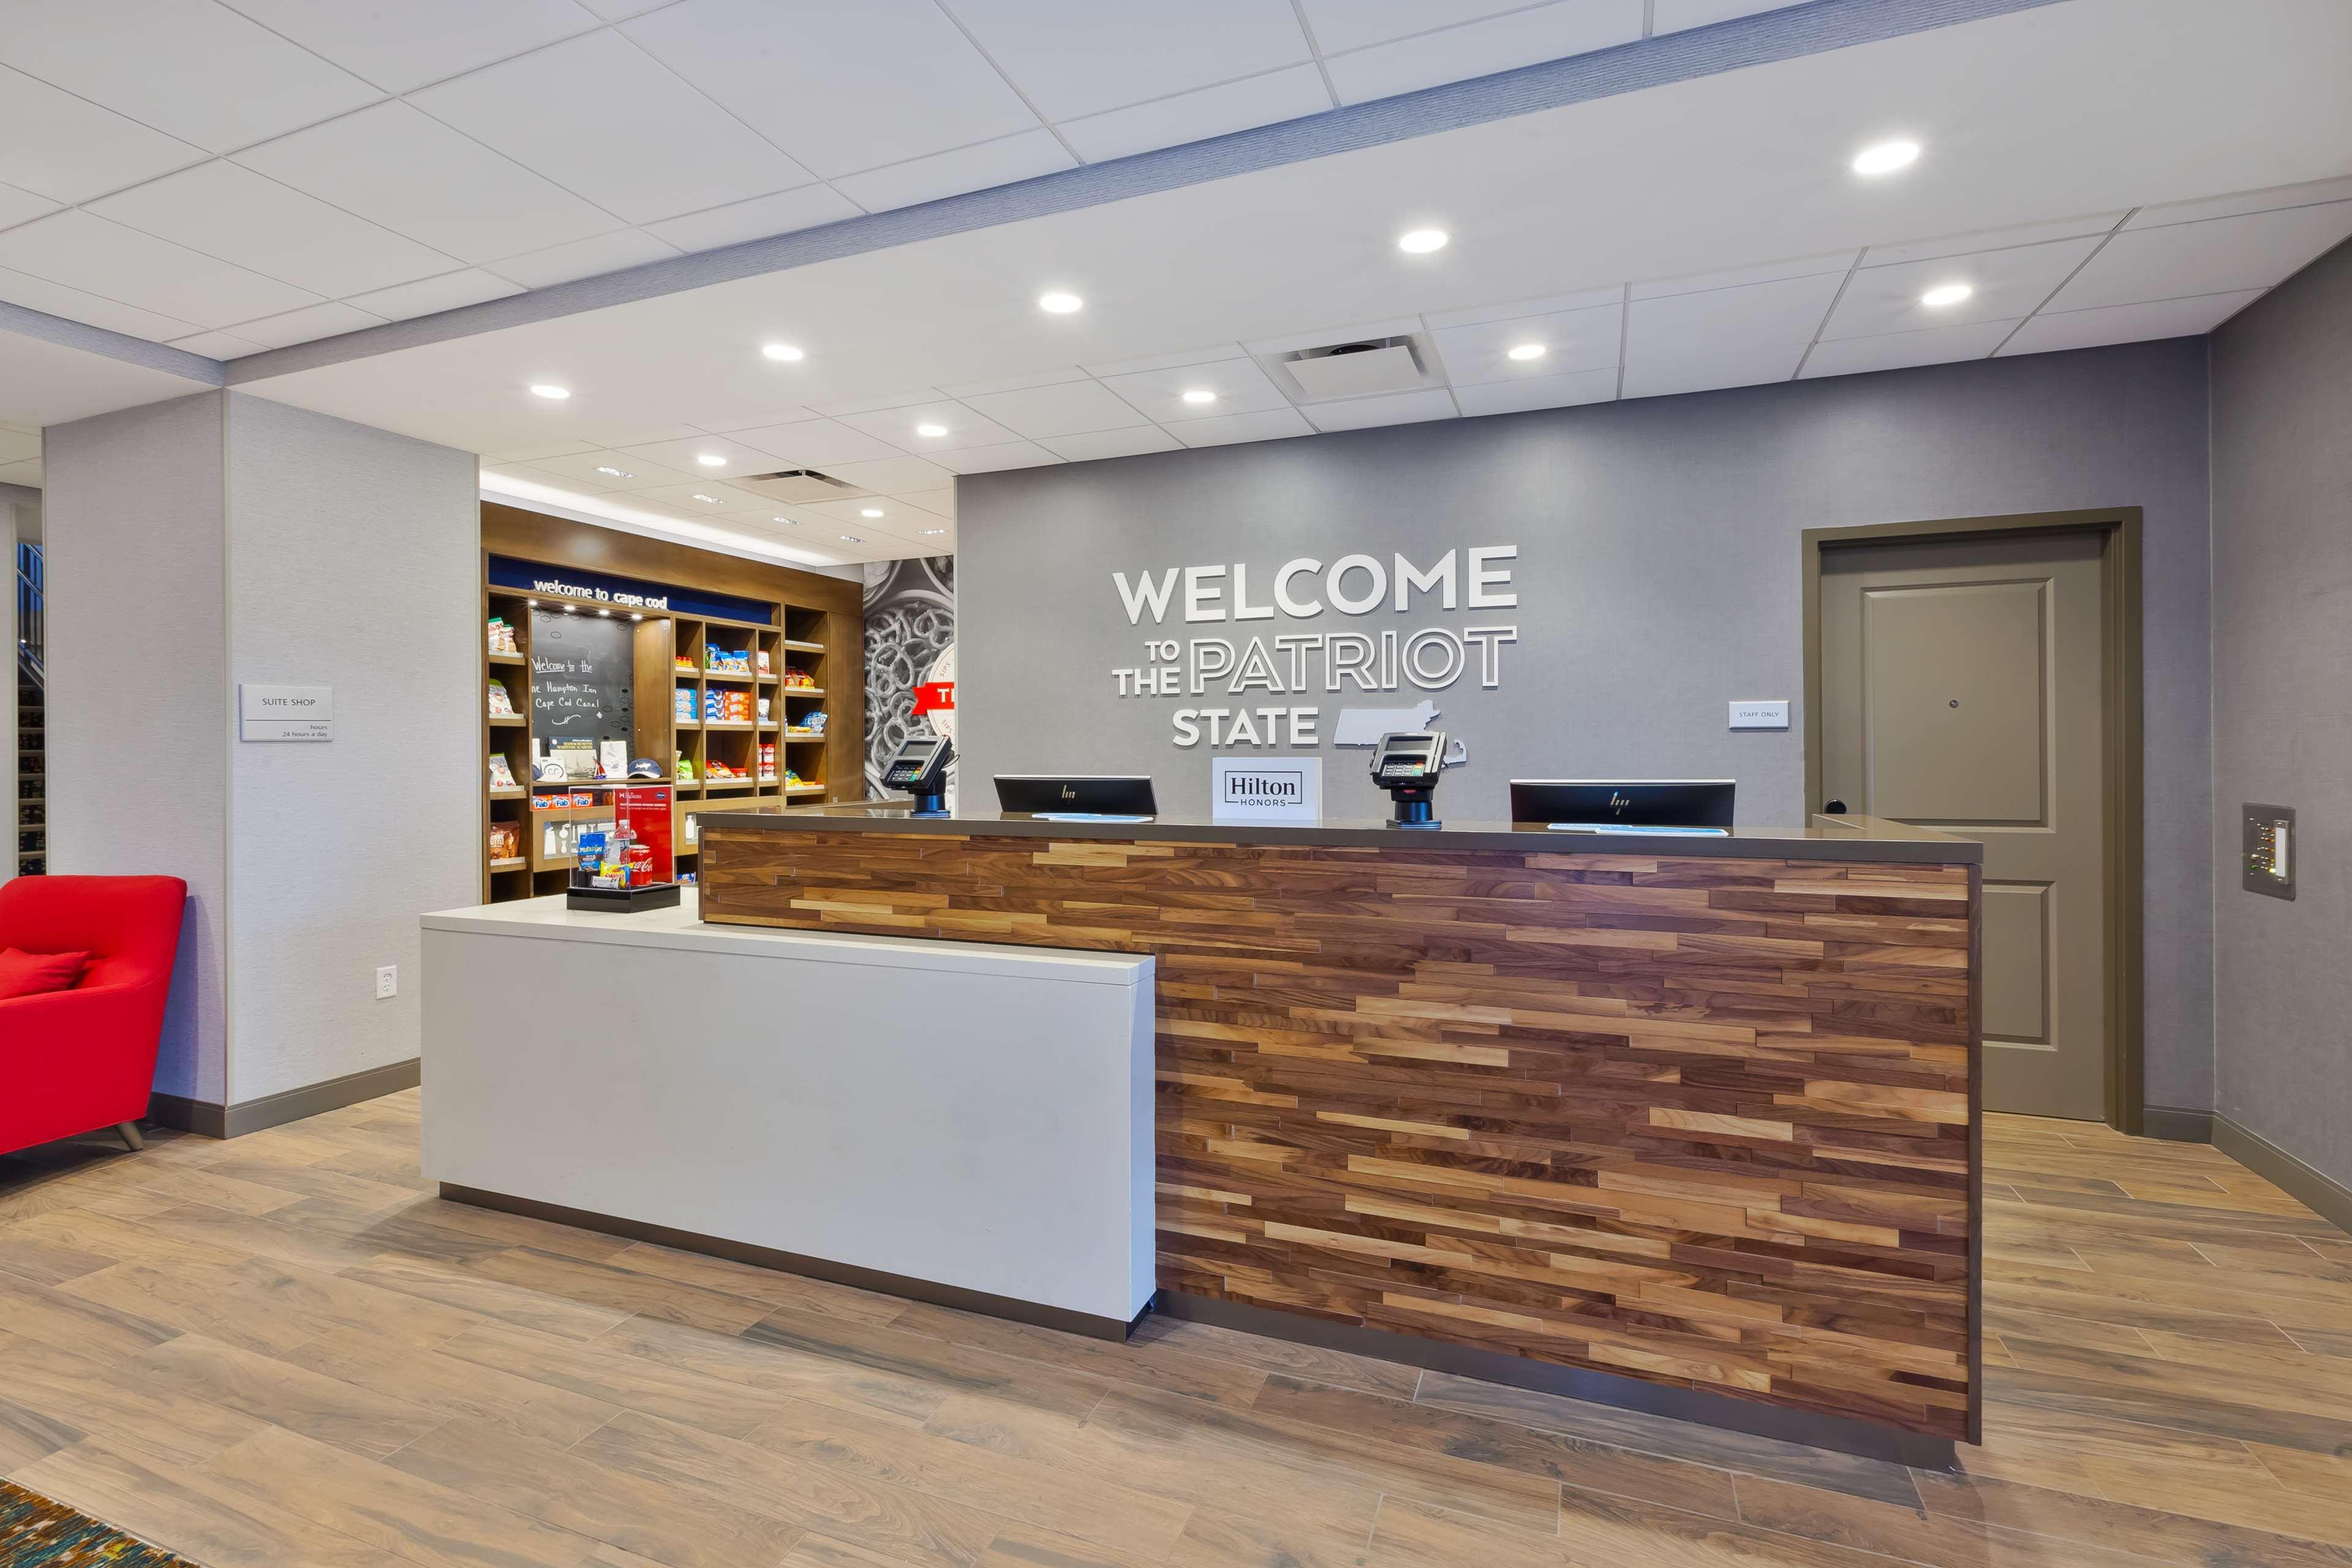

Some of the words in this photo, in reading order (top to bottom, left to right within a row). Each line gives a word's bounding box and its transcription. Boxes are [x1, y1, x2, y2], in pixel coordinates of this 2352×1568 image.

[533, 579, 593, 598] welcome
[595, 587, 609, 601] to
[613, 592, 643, 607] cape
[645, 597, 668, 609] cod
[1112, 545, 1518, 625] WELCOME
[1112, 666, 1182, 696] THE
[1189, 625, 1518, 694] PATRIOT
[1144, 639, 1180, 662] TO
[531, 656, 565, 672] Welcome
[567, 659, 575, 671] to
[579, 660, 593, 672] the
[940, 662, 951, 677] SIPS
[546, 680, 578, 694] Hampton
[582, 684, 597, 694] Inn
[535, 698, 555, 710] Cape
[558, 696, 572, 706] Cod
[576, 698, 600, 708] Canal
[1172, 706, 1319, 746] STATE
[1231, 777, 1296, 796] Hilton
